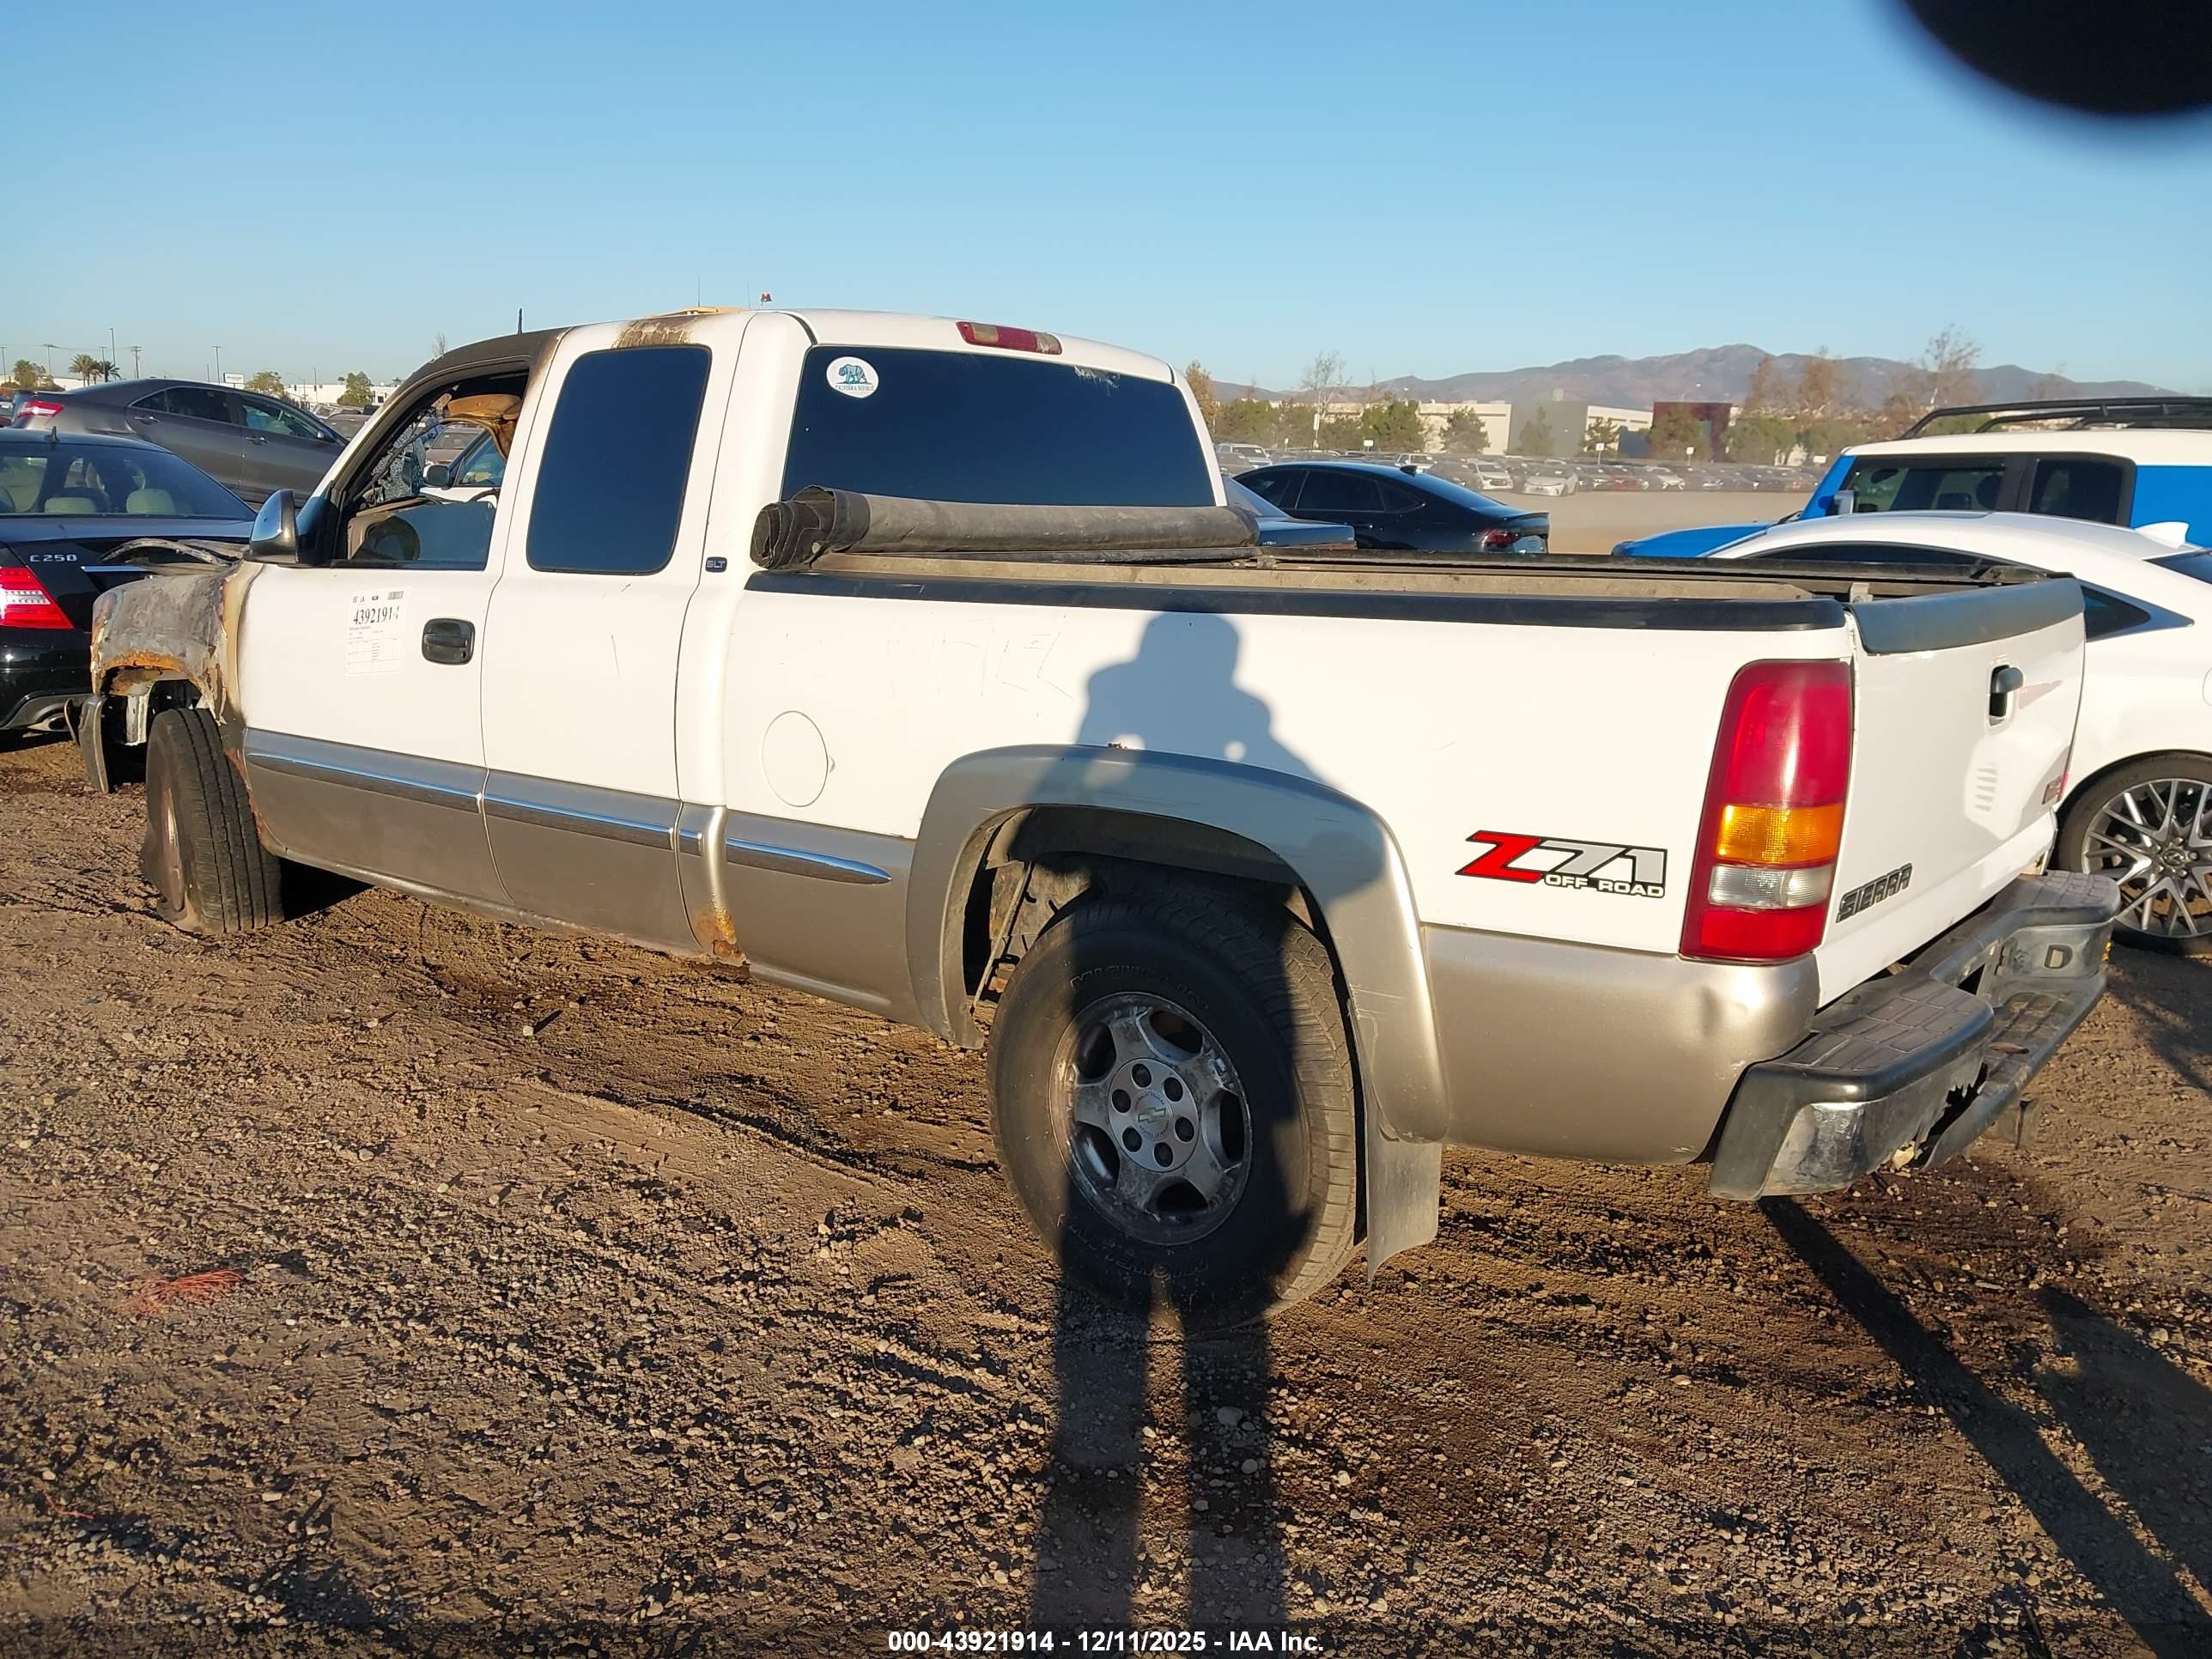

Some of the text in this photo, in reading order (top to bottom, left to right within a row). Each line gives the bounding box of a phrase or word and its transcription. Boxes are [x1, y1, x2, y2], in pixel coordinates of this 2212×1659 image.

[707, 559, 726, 568] SLT
[1455, 830, 1668, 886] Z71
[1545, 872, 1667, 899] OFF ROAD
[1835, 862, 1913, 924] SIERRA
